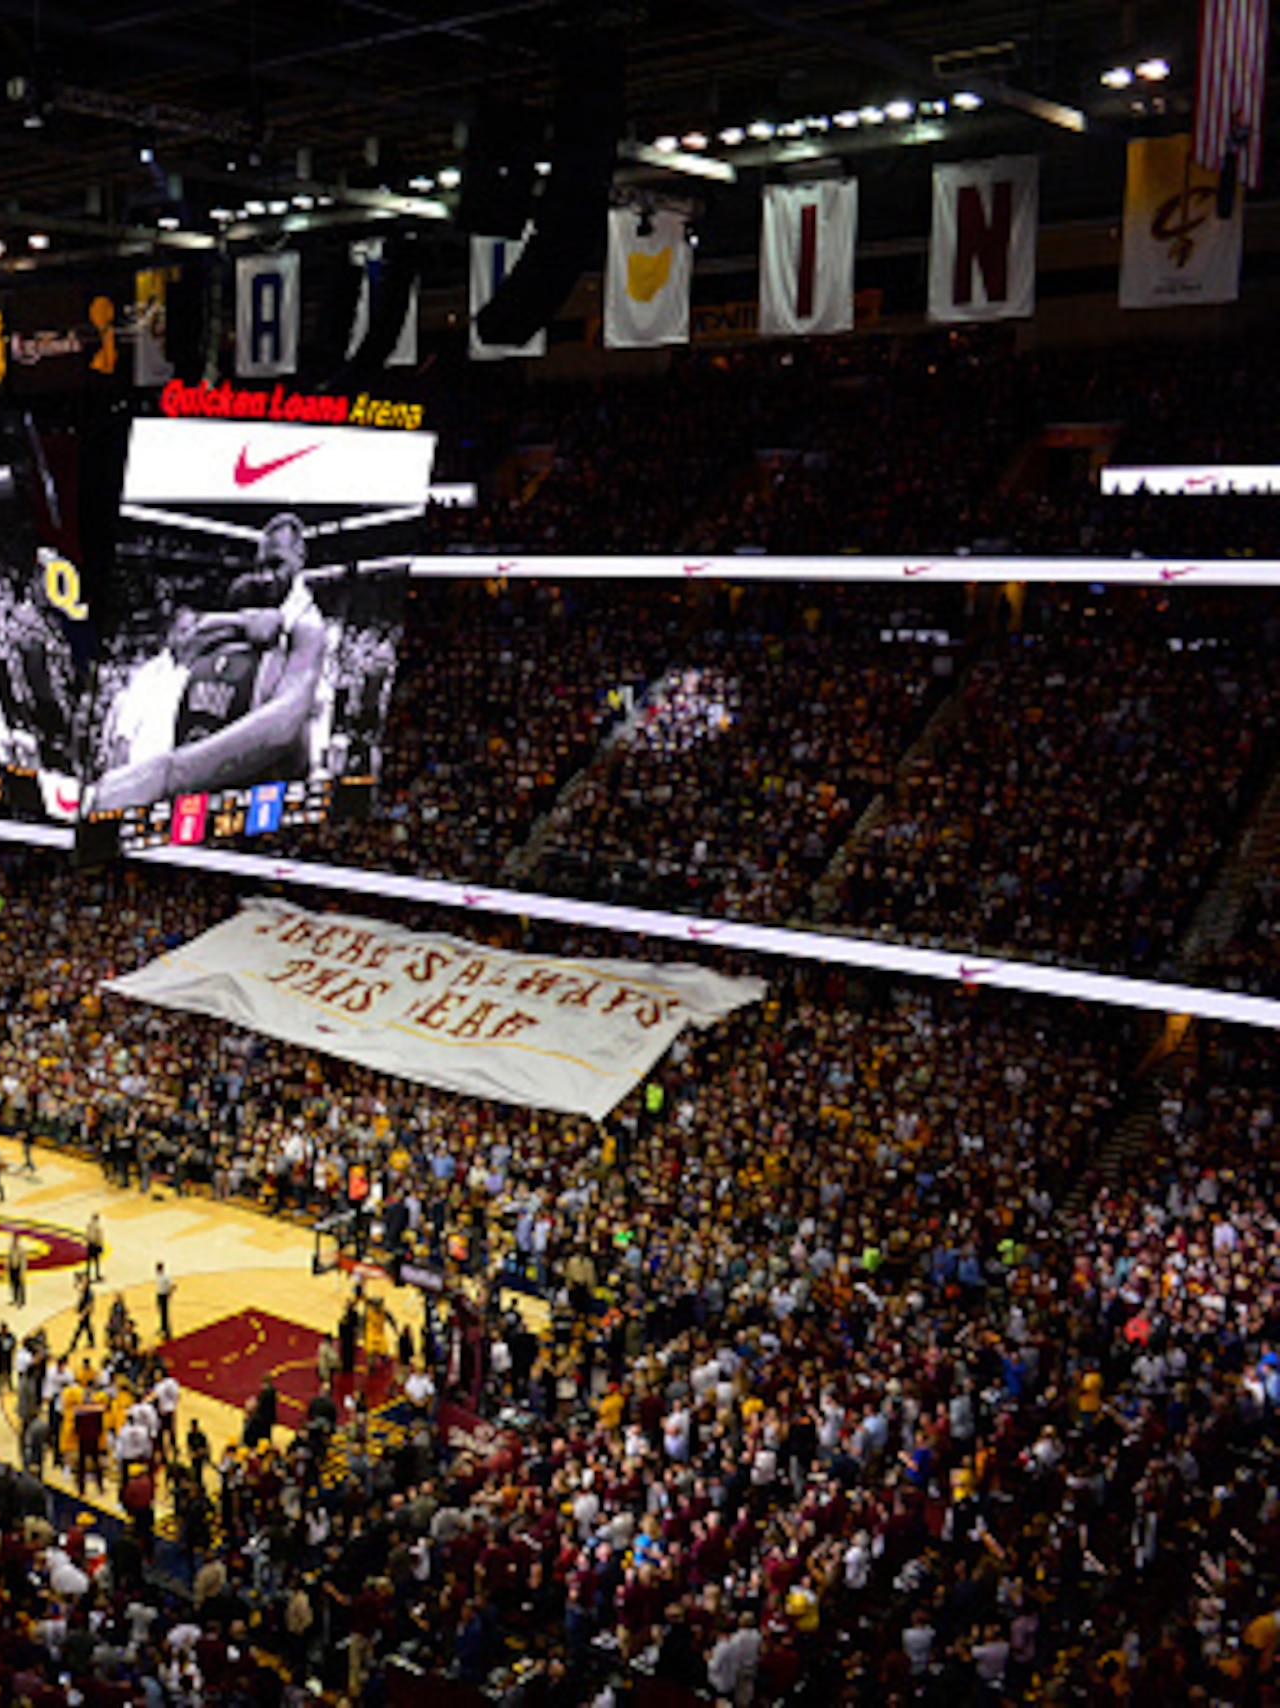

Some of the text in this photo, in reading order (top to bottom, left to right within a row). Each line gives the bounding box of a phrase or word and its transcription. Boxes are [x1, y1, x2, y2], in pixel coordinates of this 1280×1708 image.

[797, 204, 817, 318] I
[953, 181, 1013, 305] N
[252, 273, 282, 363] A
[160, 378, 423, 430] Quicken Loans Arena
[45, 562, 88, 620] Q
